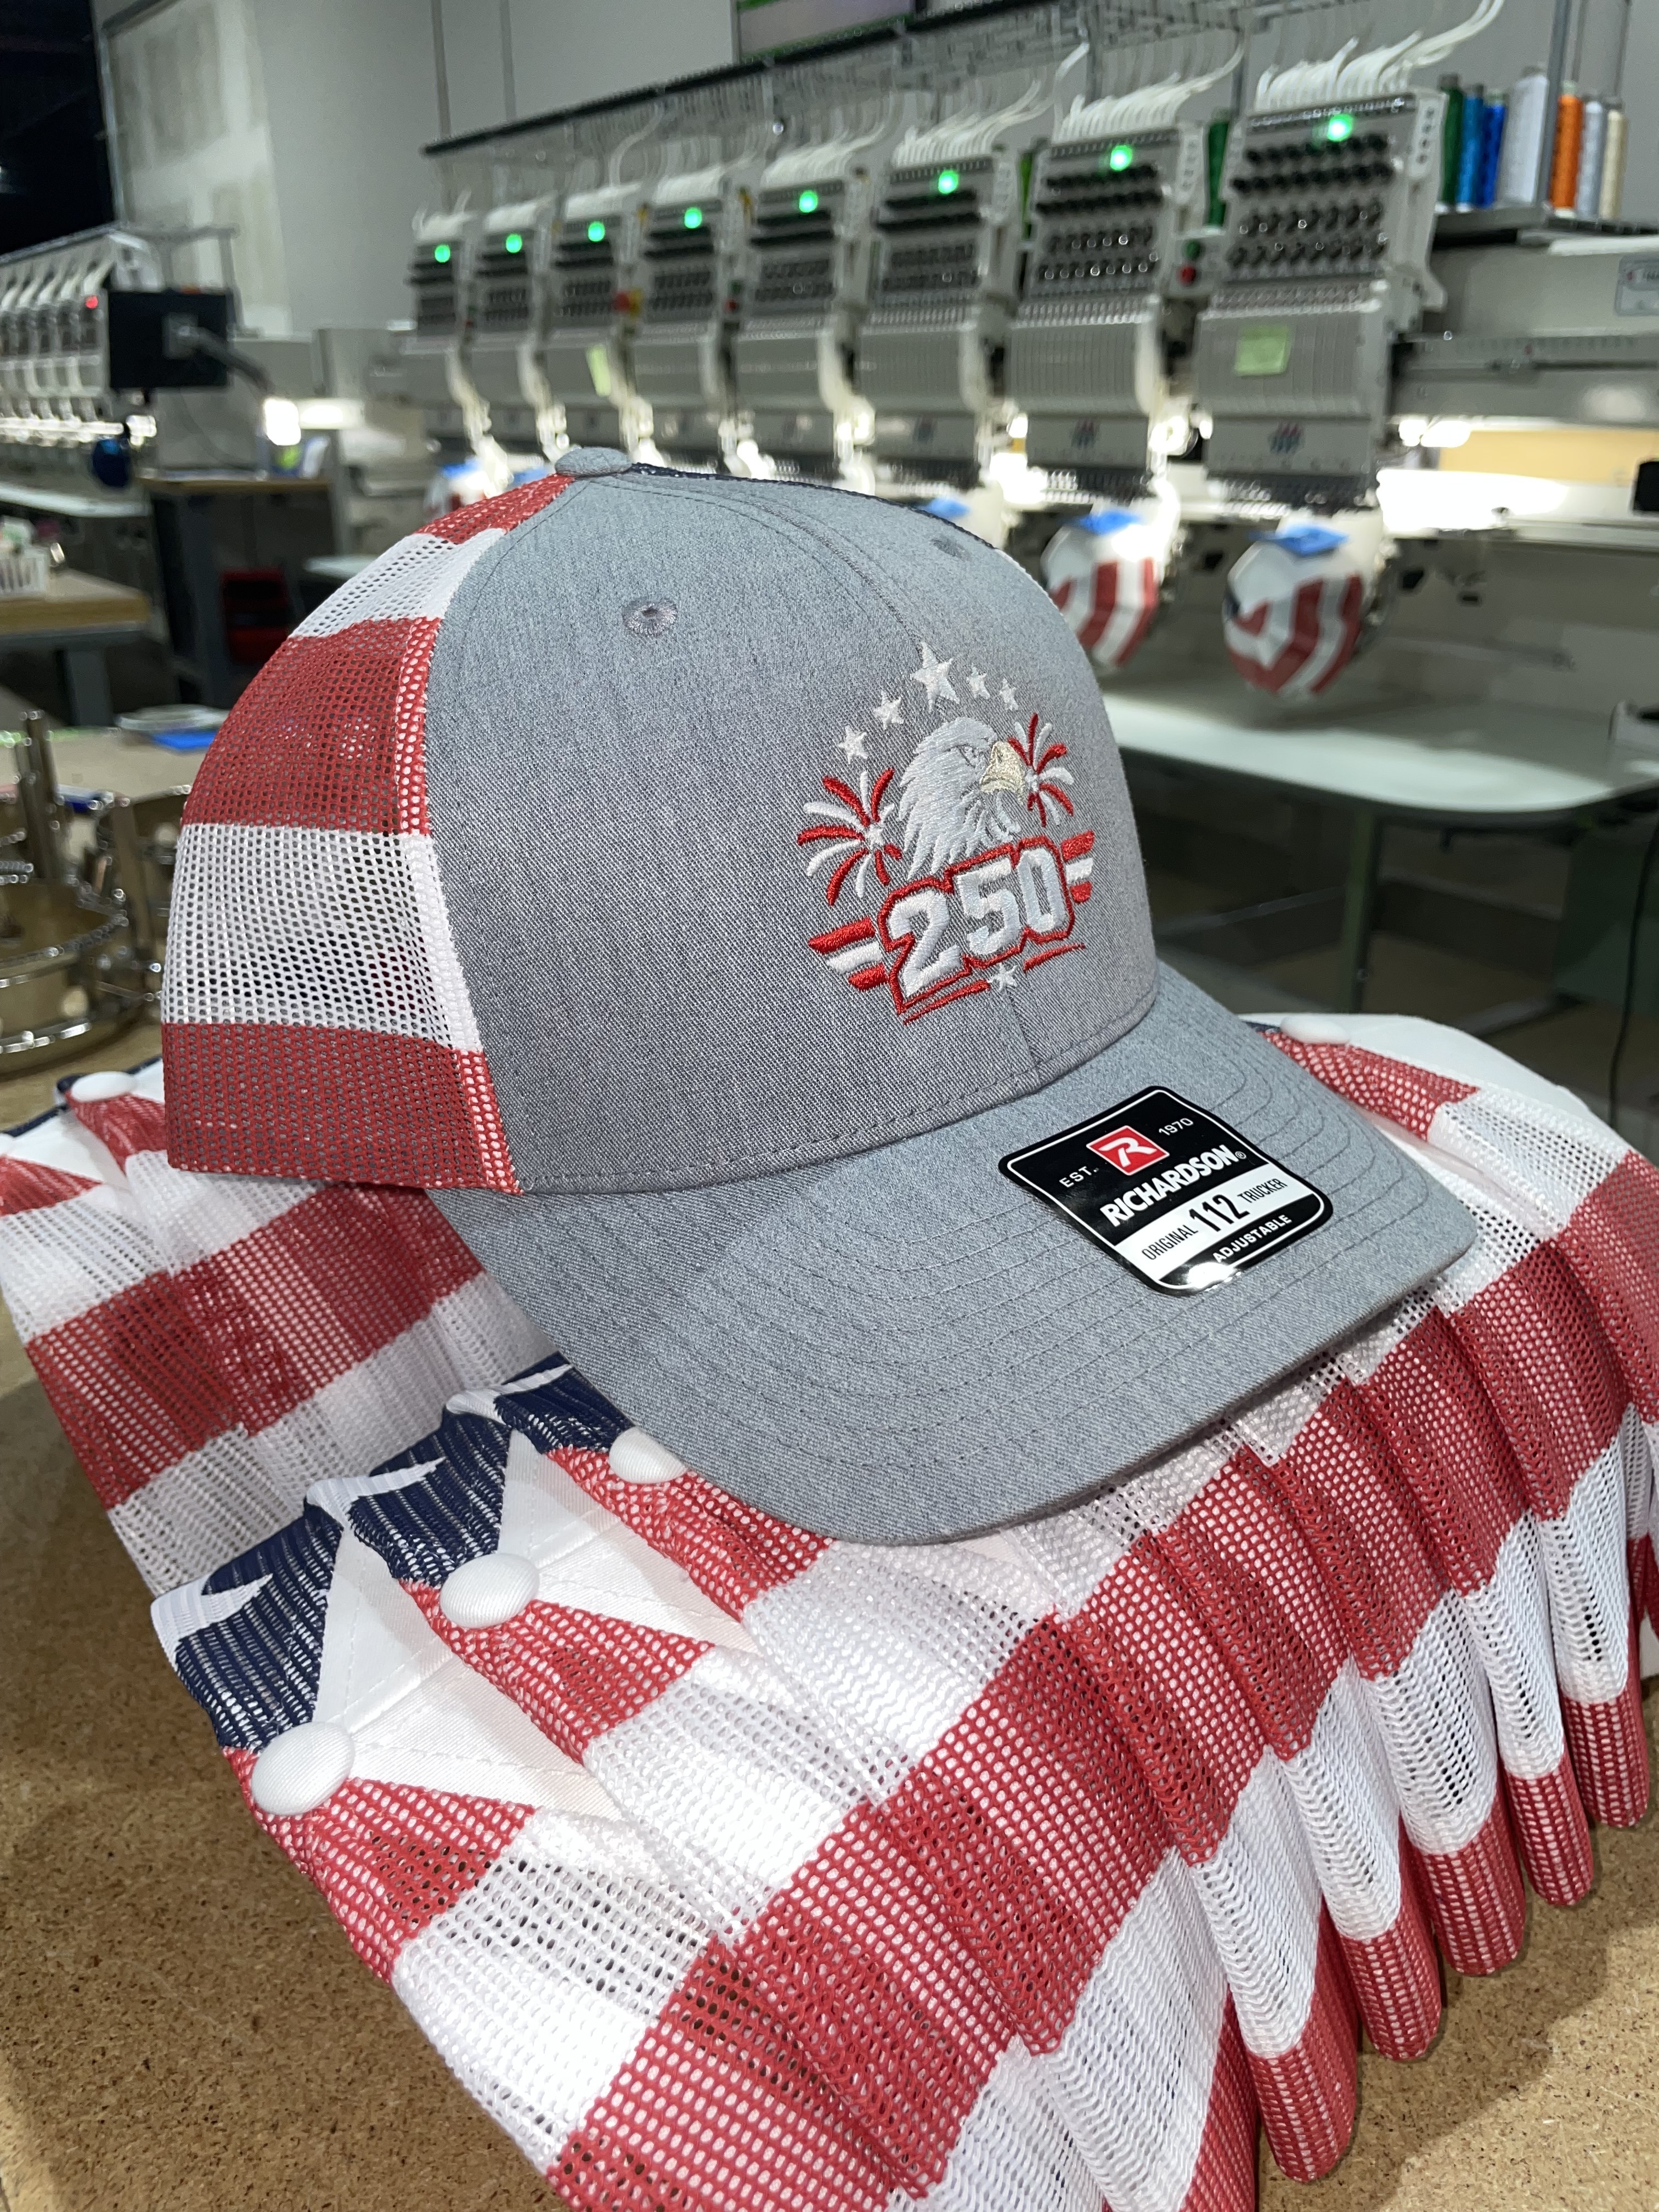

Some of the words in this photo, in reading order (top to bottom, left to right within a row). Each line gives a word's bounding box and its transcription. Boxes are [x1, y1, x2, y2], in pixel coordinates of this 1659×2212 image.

[888, 847, 1068, 998] 250
[1059, 1166, 1099, 1188] EST.
[1158, 1118, 1194, 1136] 1970
[1141, 1224, 1199, 1260] ORIGINAL
[1188, 1194, 1250, 1232] 112
[1237, 1178, 1288, 1203] TRUCKER
[1212, 1214, 1293, 1263] ADJUSTABLE
